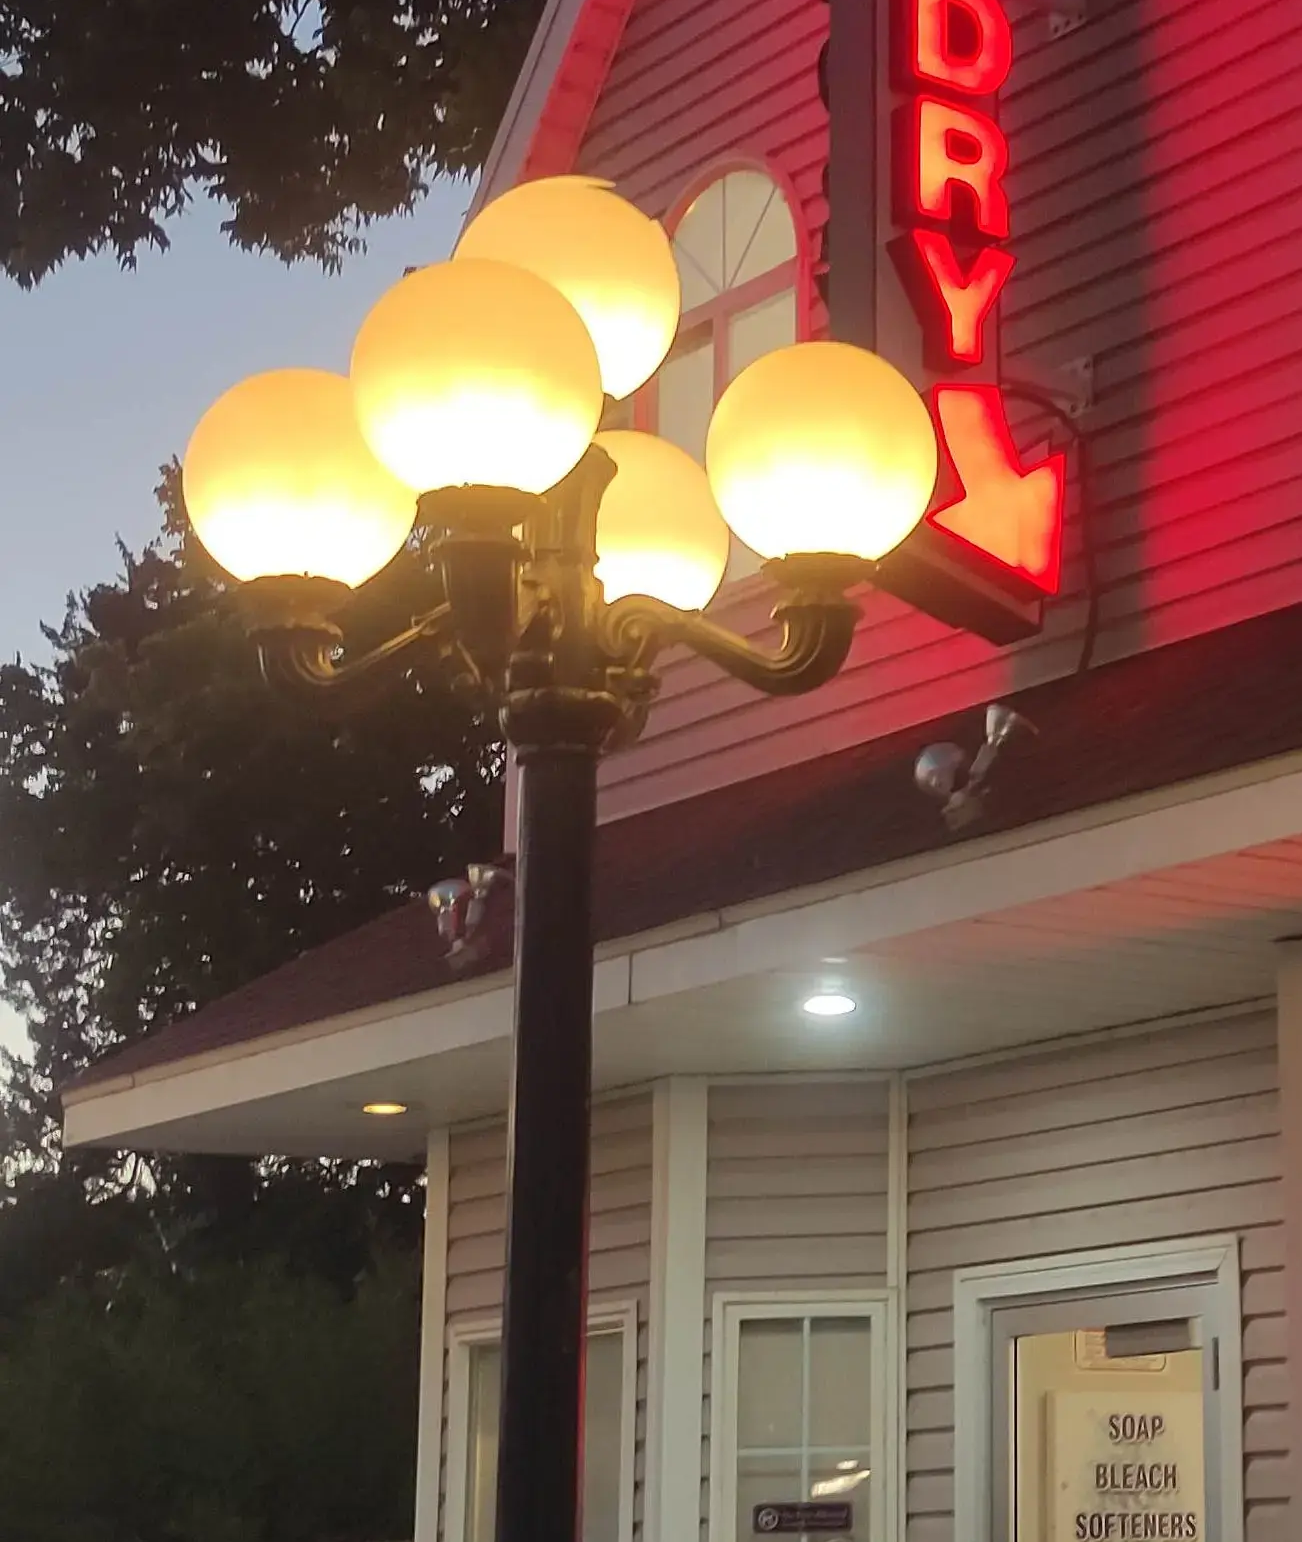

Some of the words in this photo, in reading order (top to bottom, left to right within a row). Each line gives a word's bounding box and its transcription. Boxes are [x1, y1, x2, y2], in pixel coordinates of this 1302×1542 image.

[1108, 1414, 1164, 1442] SOAP
[1095, 1463, 1177, 1490] BLEACH
[1075, 1512, 1197, 1540] SOFTENERS
